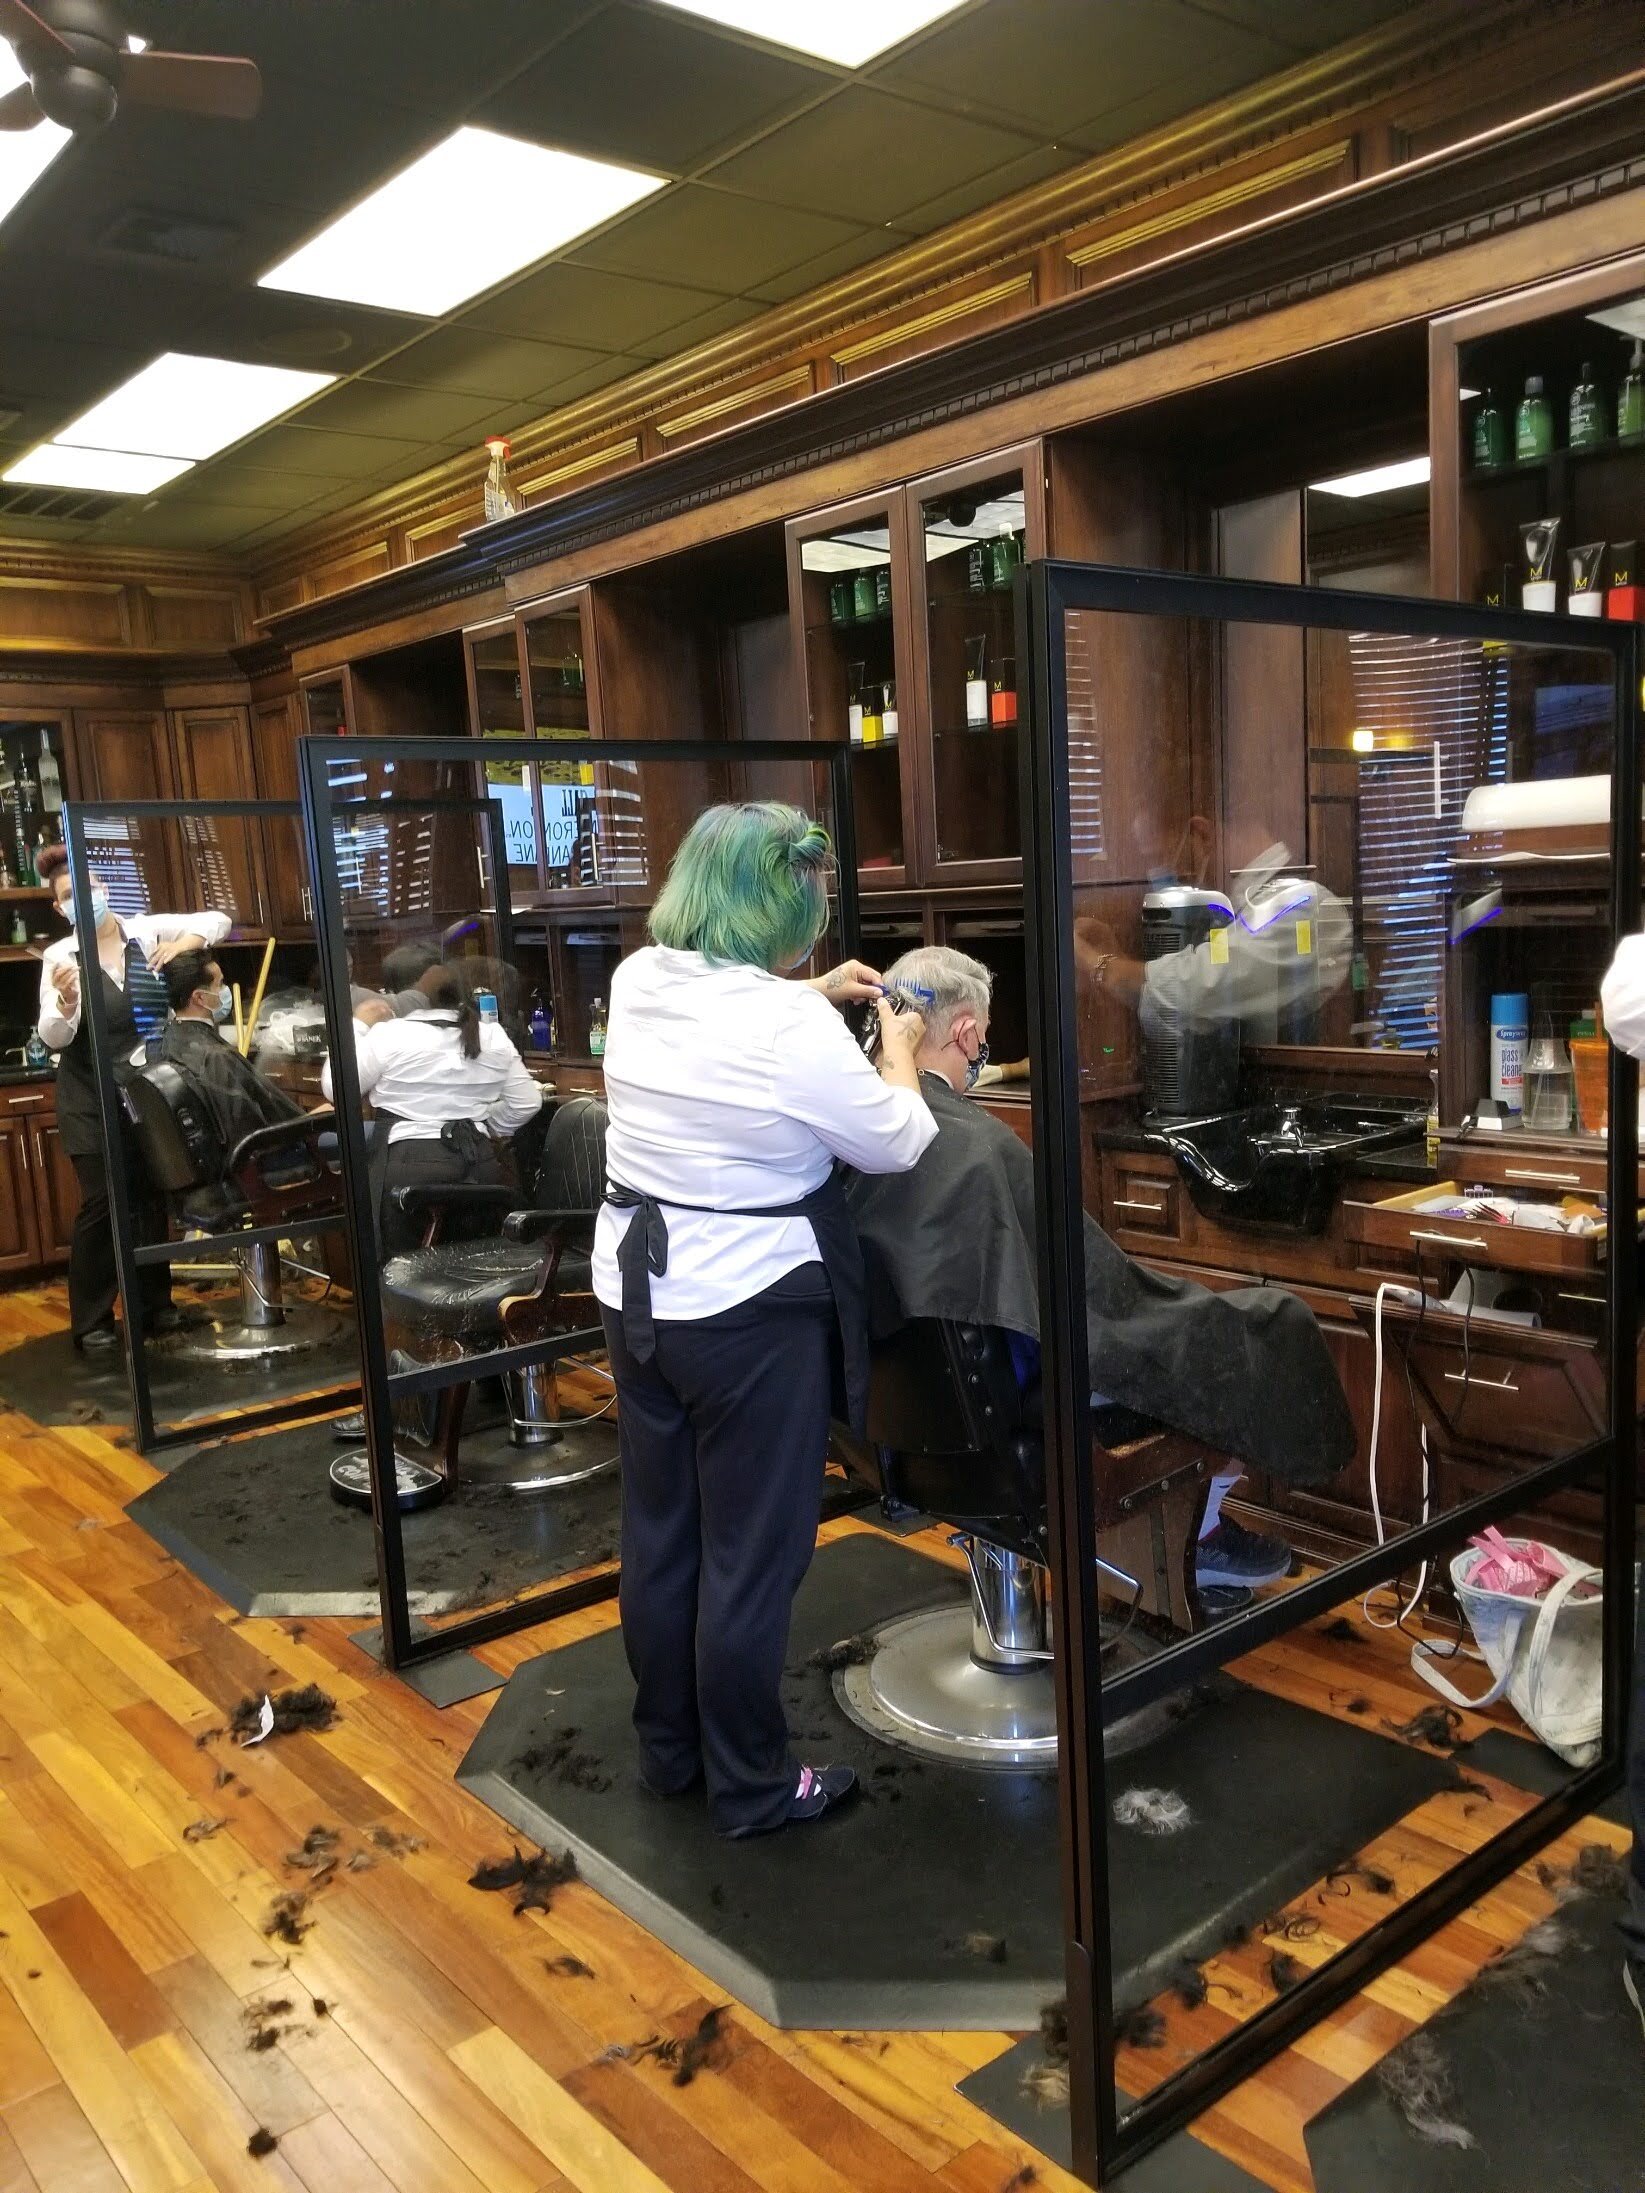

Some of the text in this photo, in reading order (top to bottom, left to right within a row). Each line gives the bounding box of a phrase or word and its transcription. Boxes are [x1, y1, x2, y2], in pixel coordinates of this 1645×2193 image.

[1530, 565, 1544, 577] M
[1615, 571, 1628, 582] M
[1575, 577, 1588, 588] M
[1487, 594, 1499, 605] M
[1501, 1048, 1519, 1064] glass
